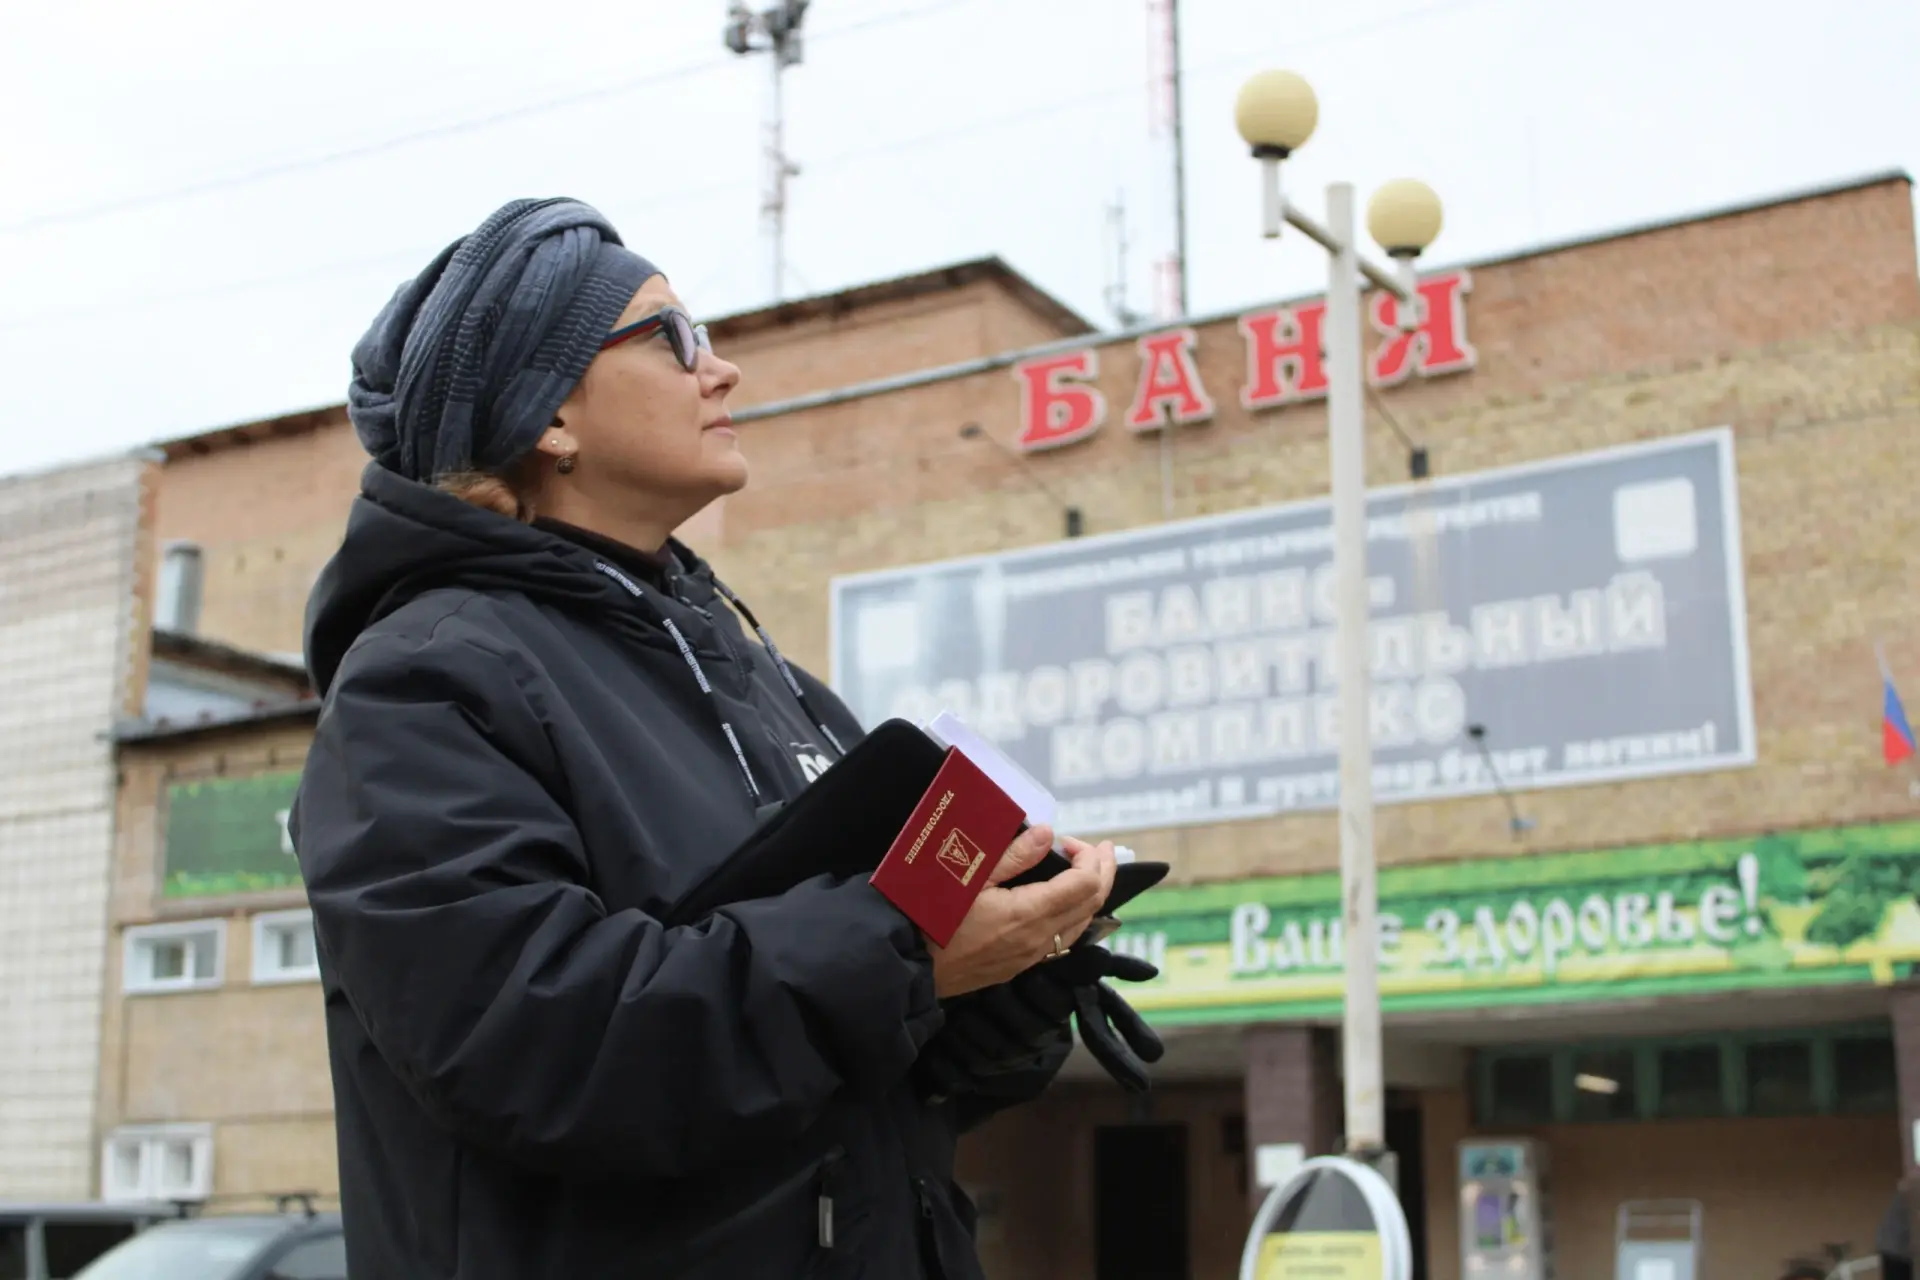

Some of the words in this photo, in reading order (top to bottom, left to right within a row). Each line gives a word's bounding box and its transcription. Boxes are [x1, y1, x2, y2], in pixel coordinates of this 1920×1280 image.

[1013, 270, 1478, 452] БАНЯ
[1050, 673, 1467, 787] КОМПЛЕКС
[904, 790, 955, 865] УДОСТОВЕРЕНИЕ
[1425, 852, 1763, 974] здоровье!
